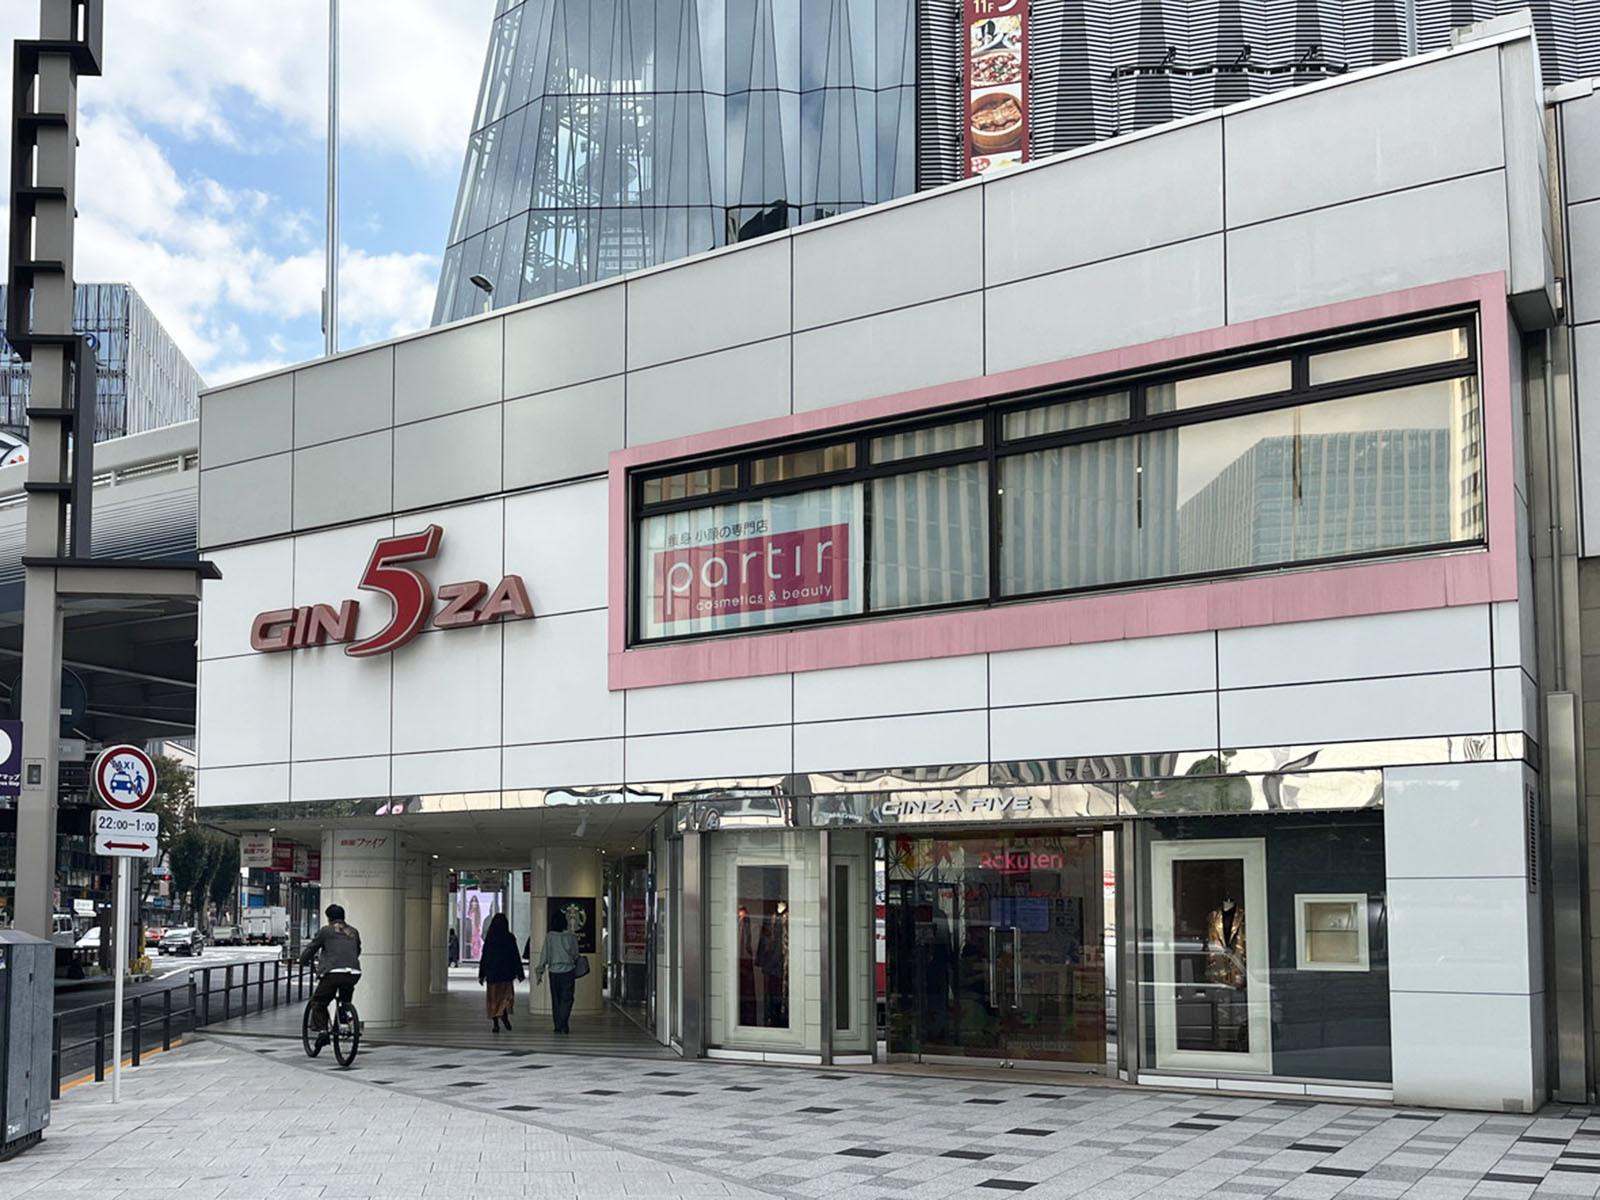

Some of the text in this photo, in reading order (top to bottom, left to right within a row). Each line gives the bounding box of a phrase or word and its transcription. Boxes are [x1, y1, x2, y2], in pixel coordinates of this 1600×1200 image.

[972, 0, 995, 13] 11F
[696, 519, 769, 543] 小顔の専門店
[666, 540, 833, 615] partir
[696, 583, 833, 612] cosmetics & beauty
[881, 796, 1033, 816] GINZA FIVE
[98, 816, 157, 832] 22:00-1:00
[979, 850, 1064, 872] Rakuten
